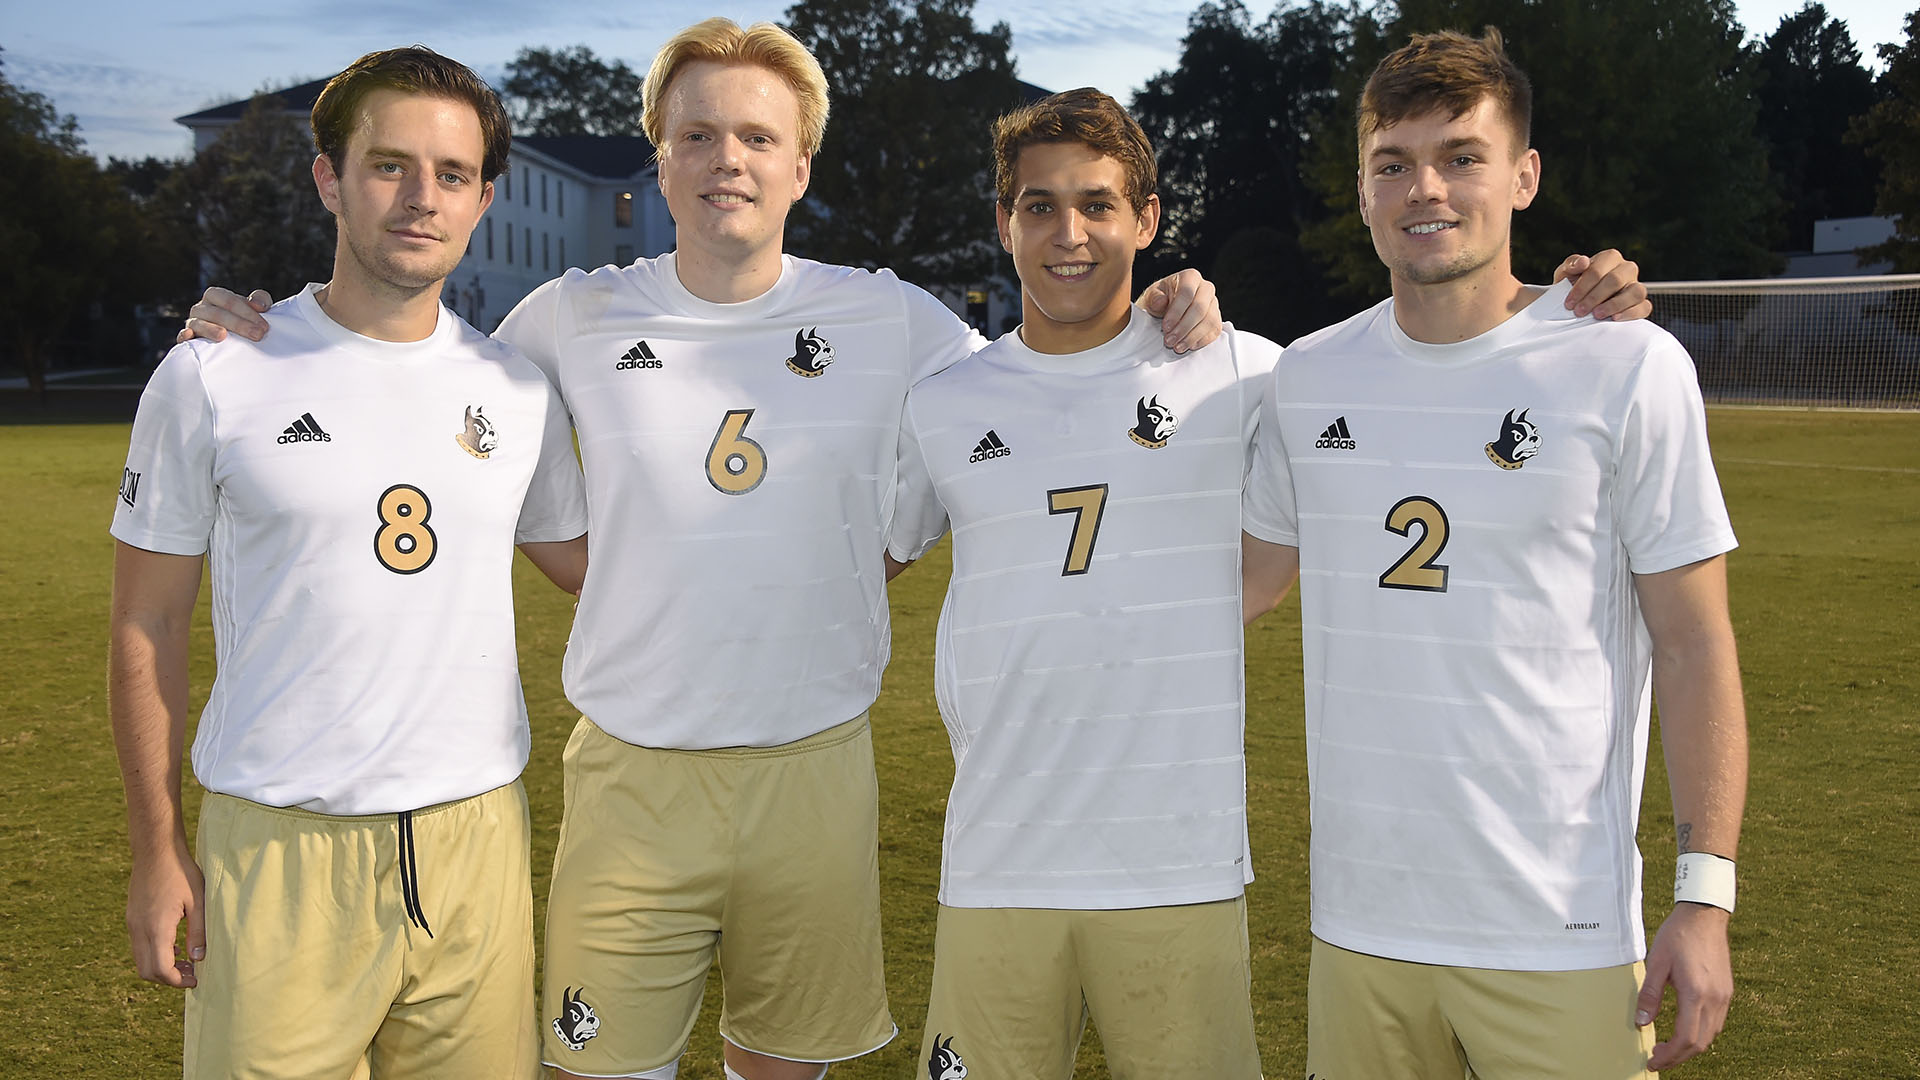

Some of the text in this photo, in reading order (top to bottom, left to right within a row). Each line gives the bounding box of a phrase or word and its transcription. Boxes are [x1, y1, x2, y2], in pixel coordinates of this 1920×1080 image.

[615, 358, 663, 370] adidas
[277, 432, 331, 444] adidas
[705, 409, 768, 495] 6
[969, 446, 1011, 463] adidas
[1315, 437, 1356, 450] adidas
[373, 484, 438, 575] 8
[1047, 483, 1109, 576] 7
[1379, 495, 1450, 593] 2
